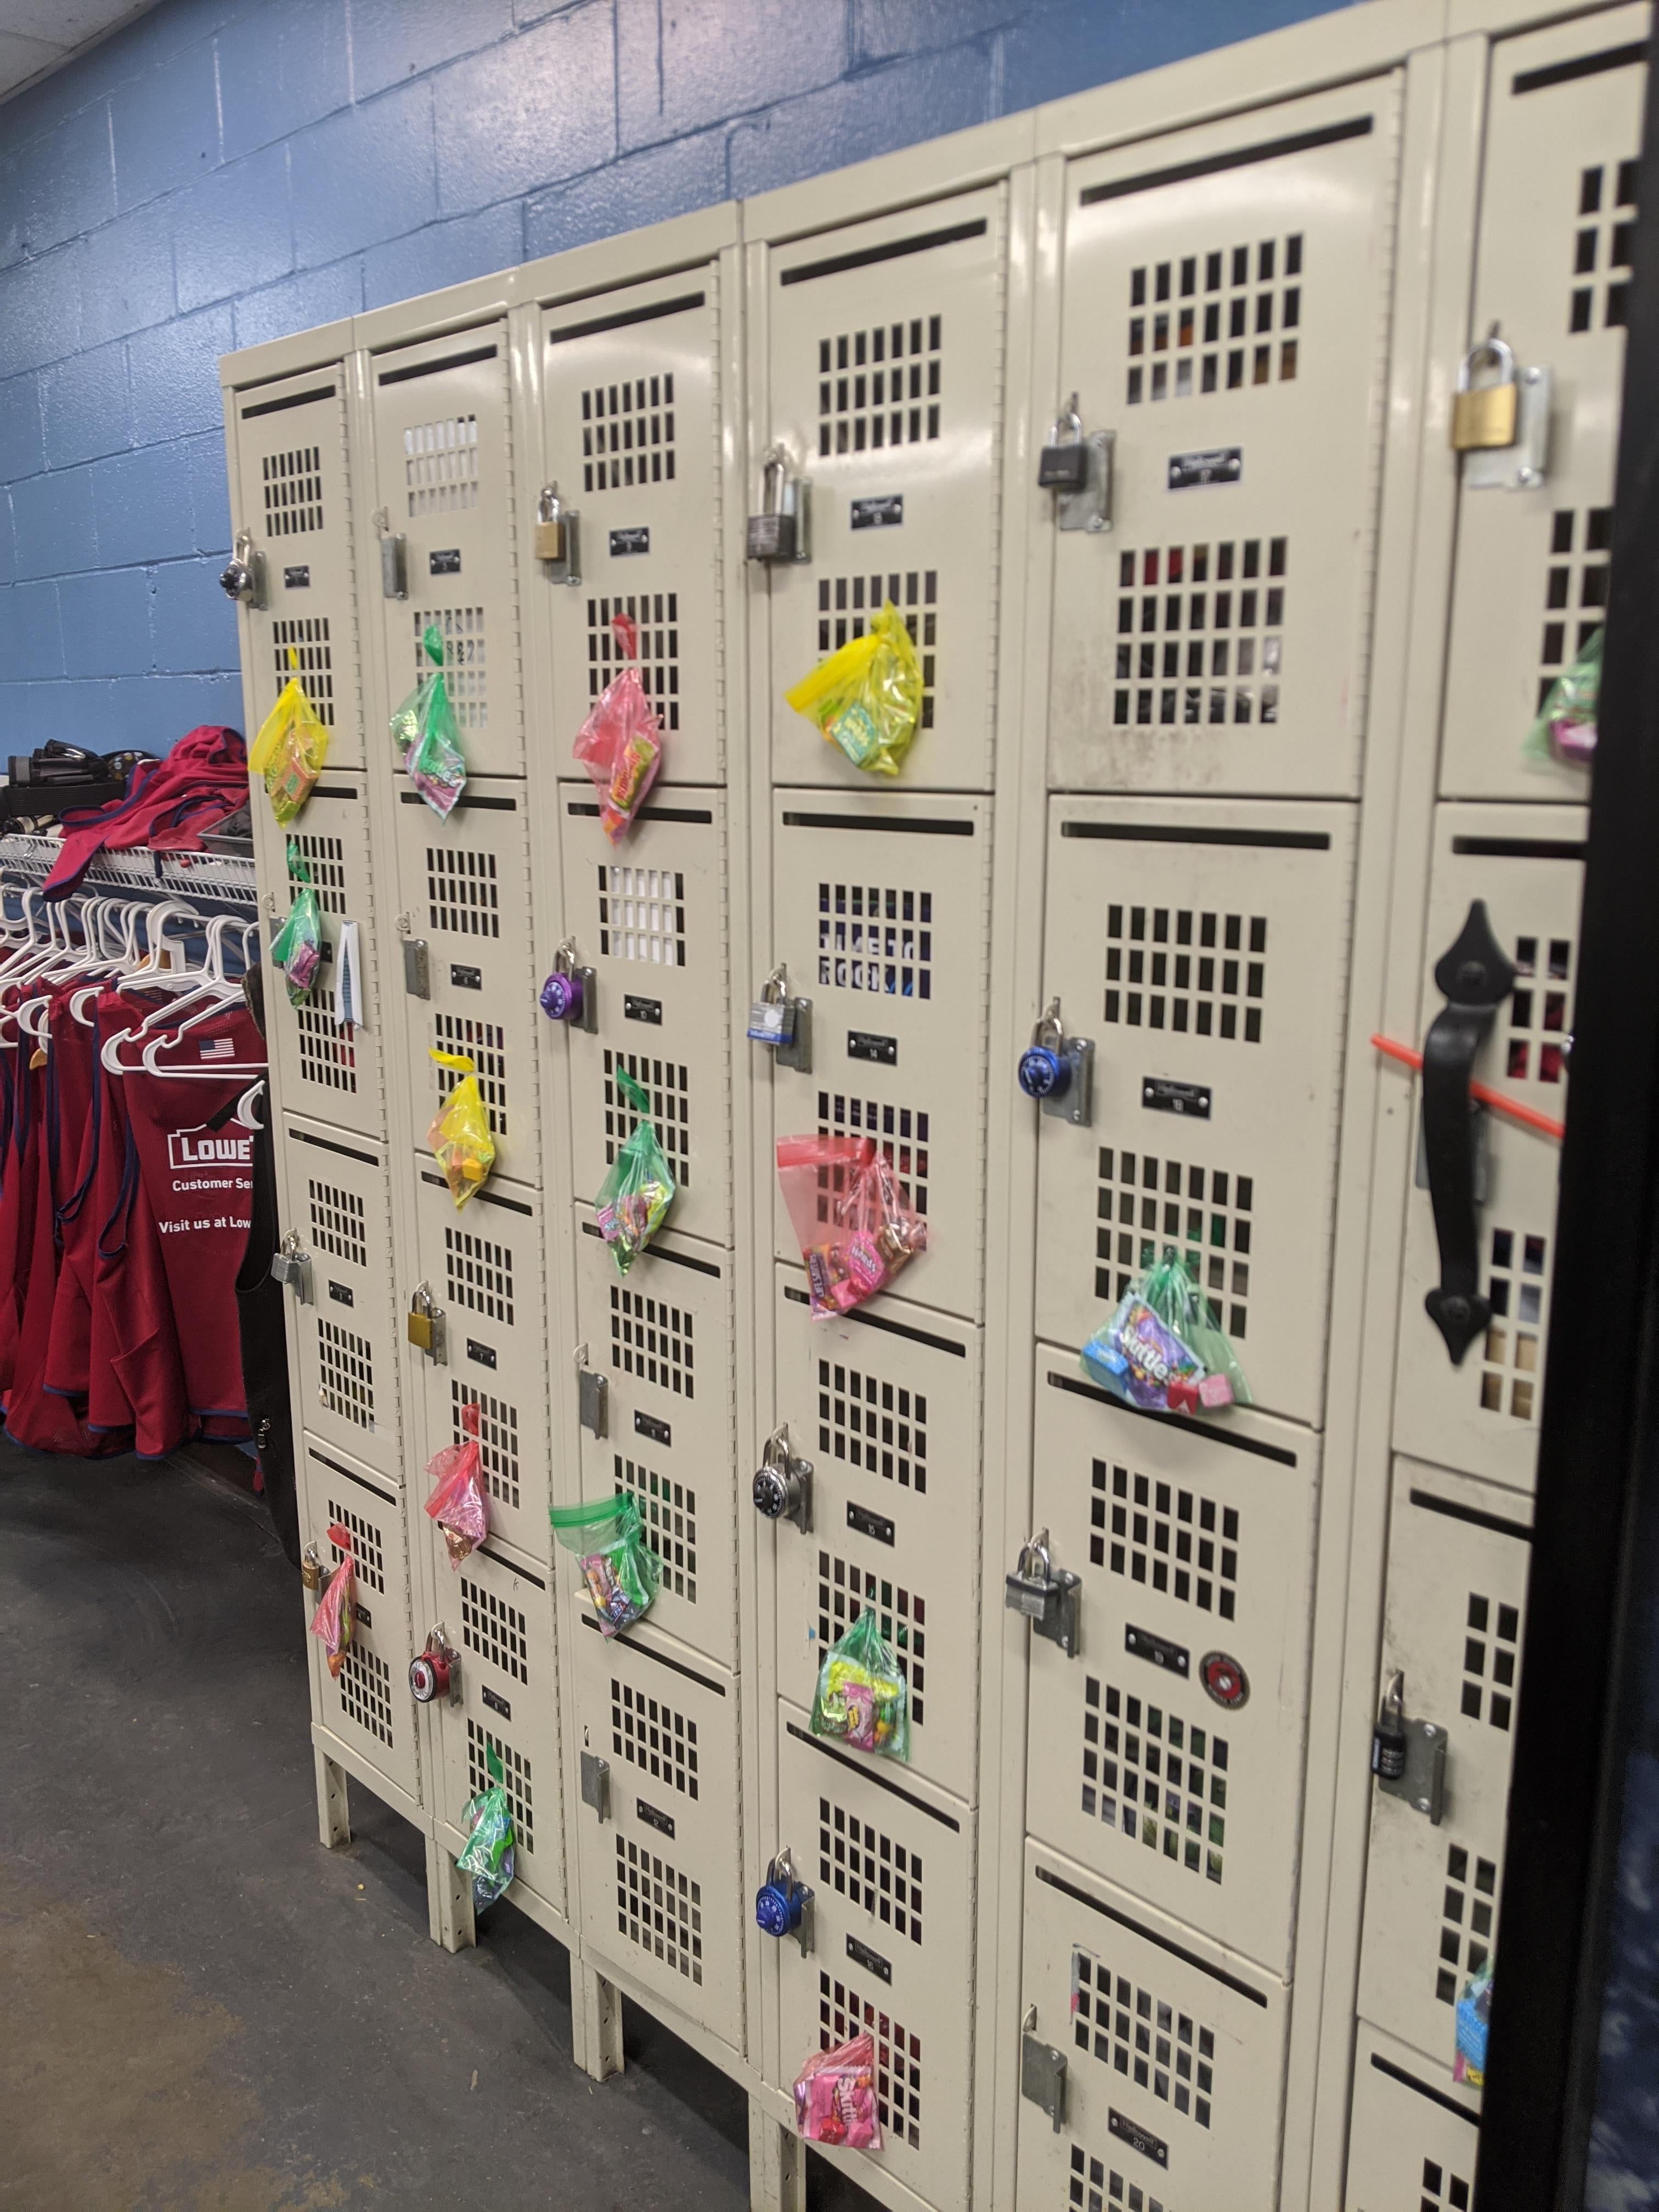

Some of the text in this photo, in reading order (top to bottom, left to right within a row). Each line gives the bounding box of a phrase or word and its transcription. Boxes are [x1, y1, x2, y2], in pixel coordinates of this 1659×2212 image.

[172, 1179, 233, 1192] Customer
[159, 1219, 190, 1233] Visit
[194, 1219, 211, 1229] us
[214, 1216, 227, 1228] at
[1133, 2137, 1145, 2151] 20
